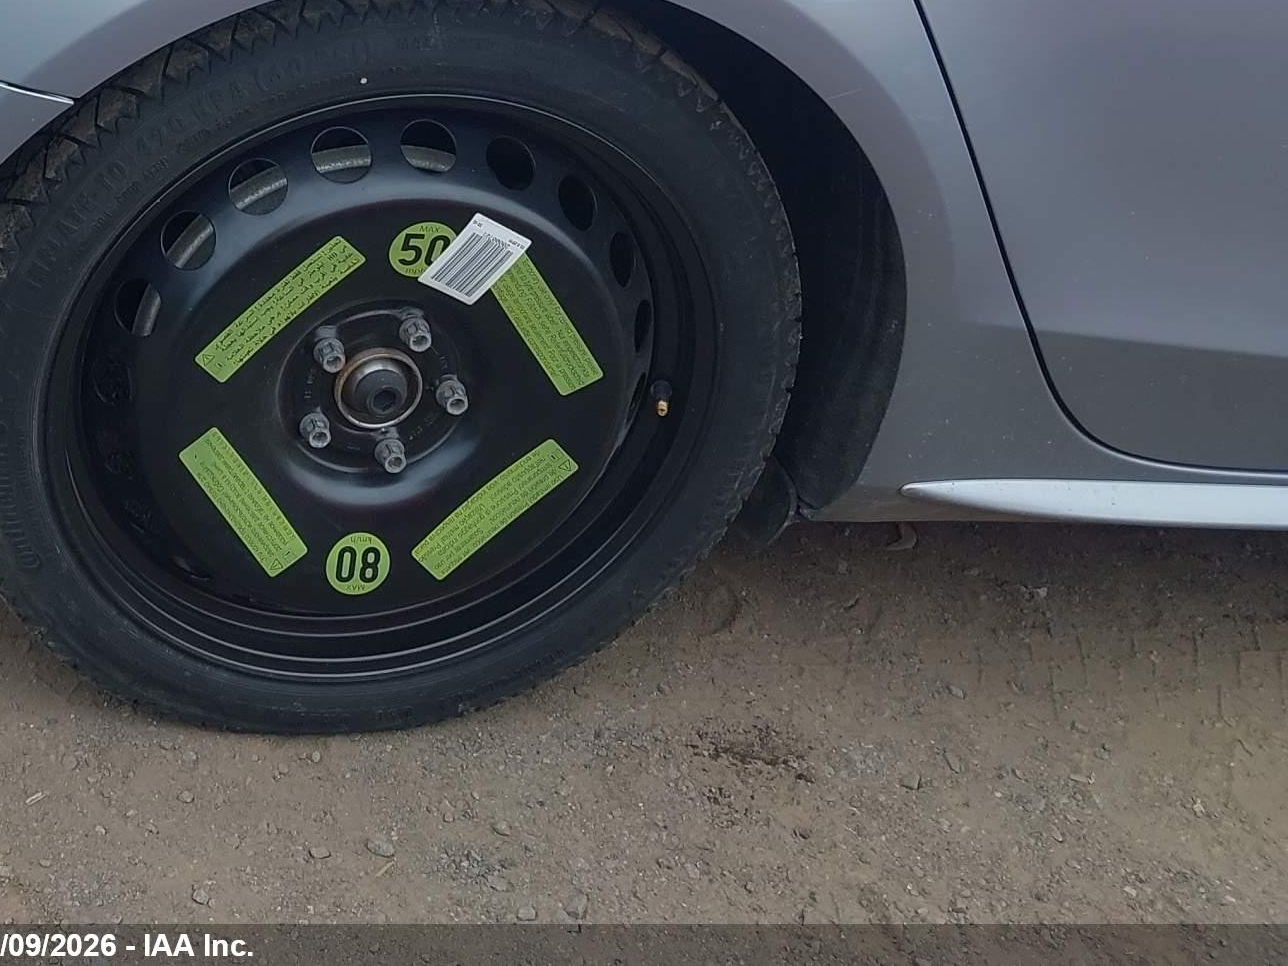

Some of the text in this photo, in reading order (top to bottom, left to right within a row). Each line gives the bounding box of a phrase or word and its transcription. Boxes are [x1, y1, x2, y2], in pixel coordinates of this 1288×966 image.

[419, 225, 441, 233] MAX
[398, 233, 451, 267] 50
[349, 536, 372, 545] km/h
[334, 546, 380, 583] 80
[344, 583, 366, 591] MAX
